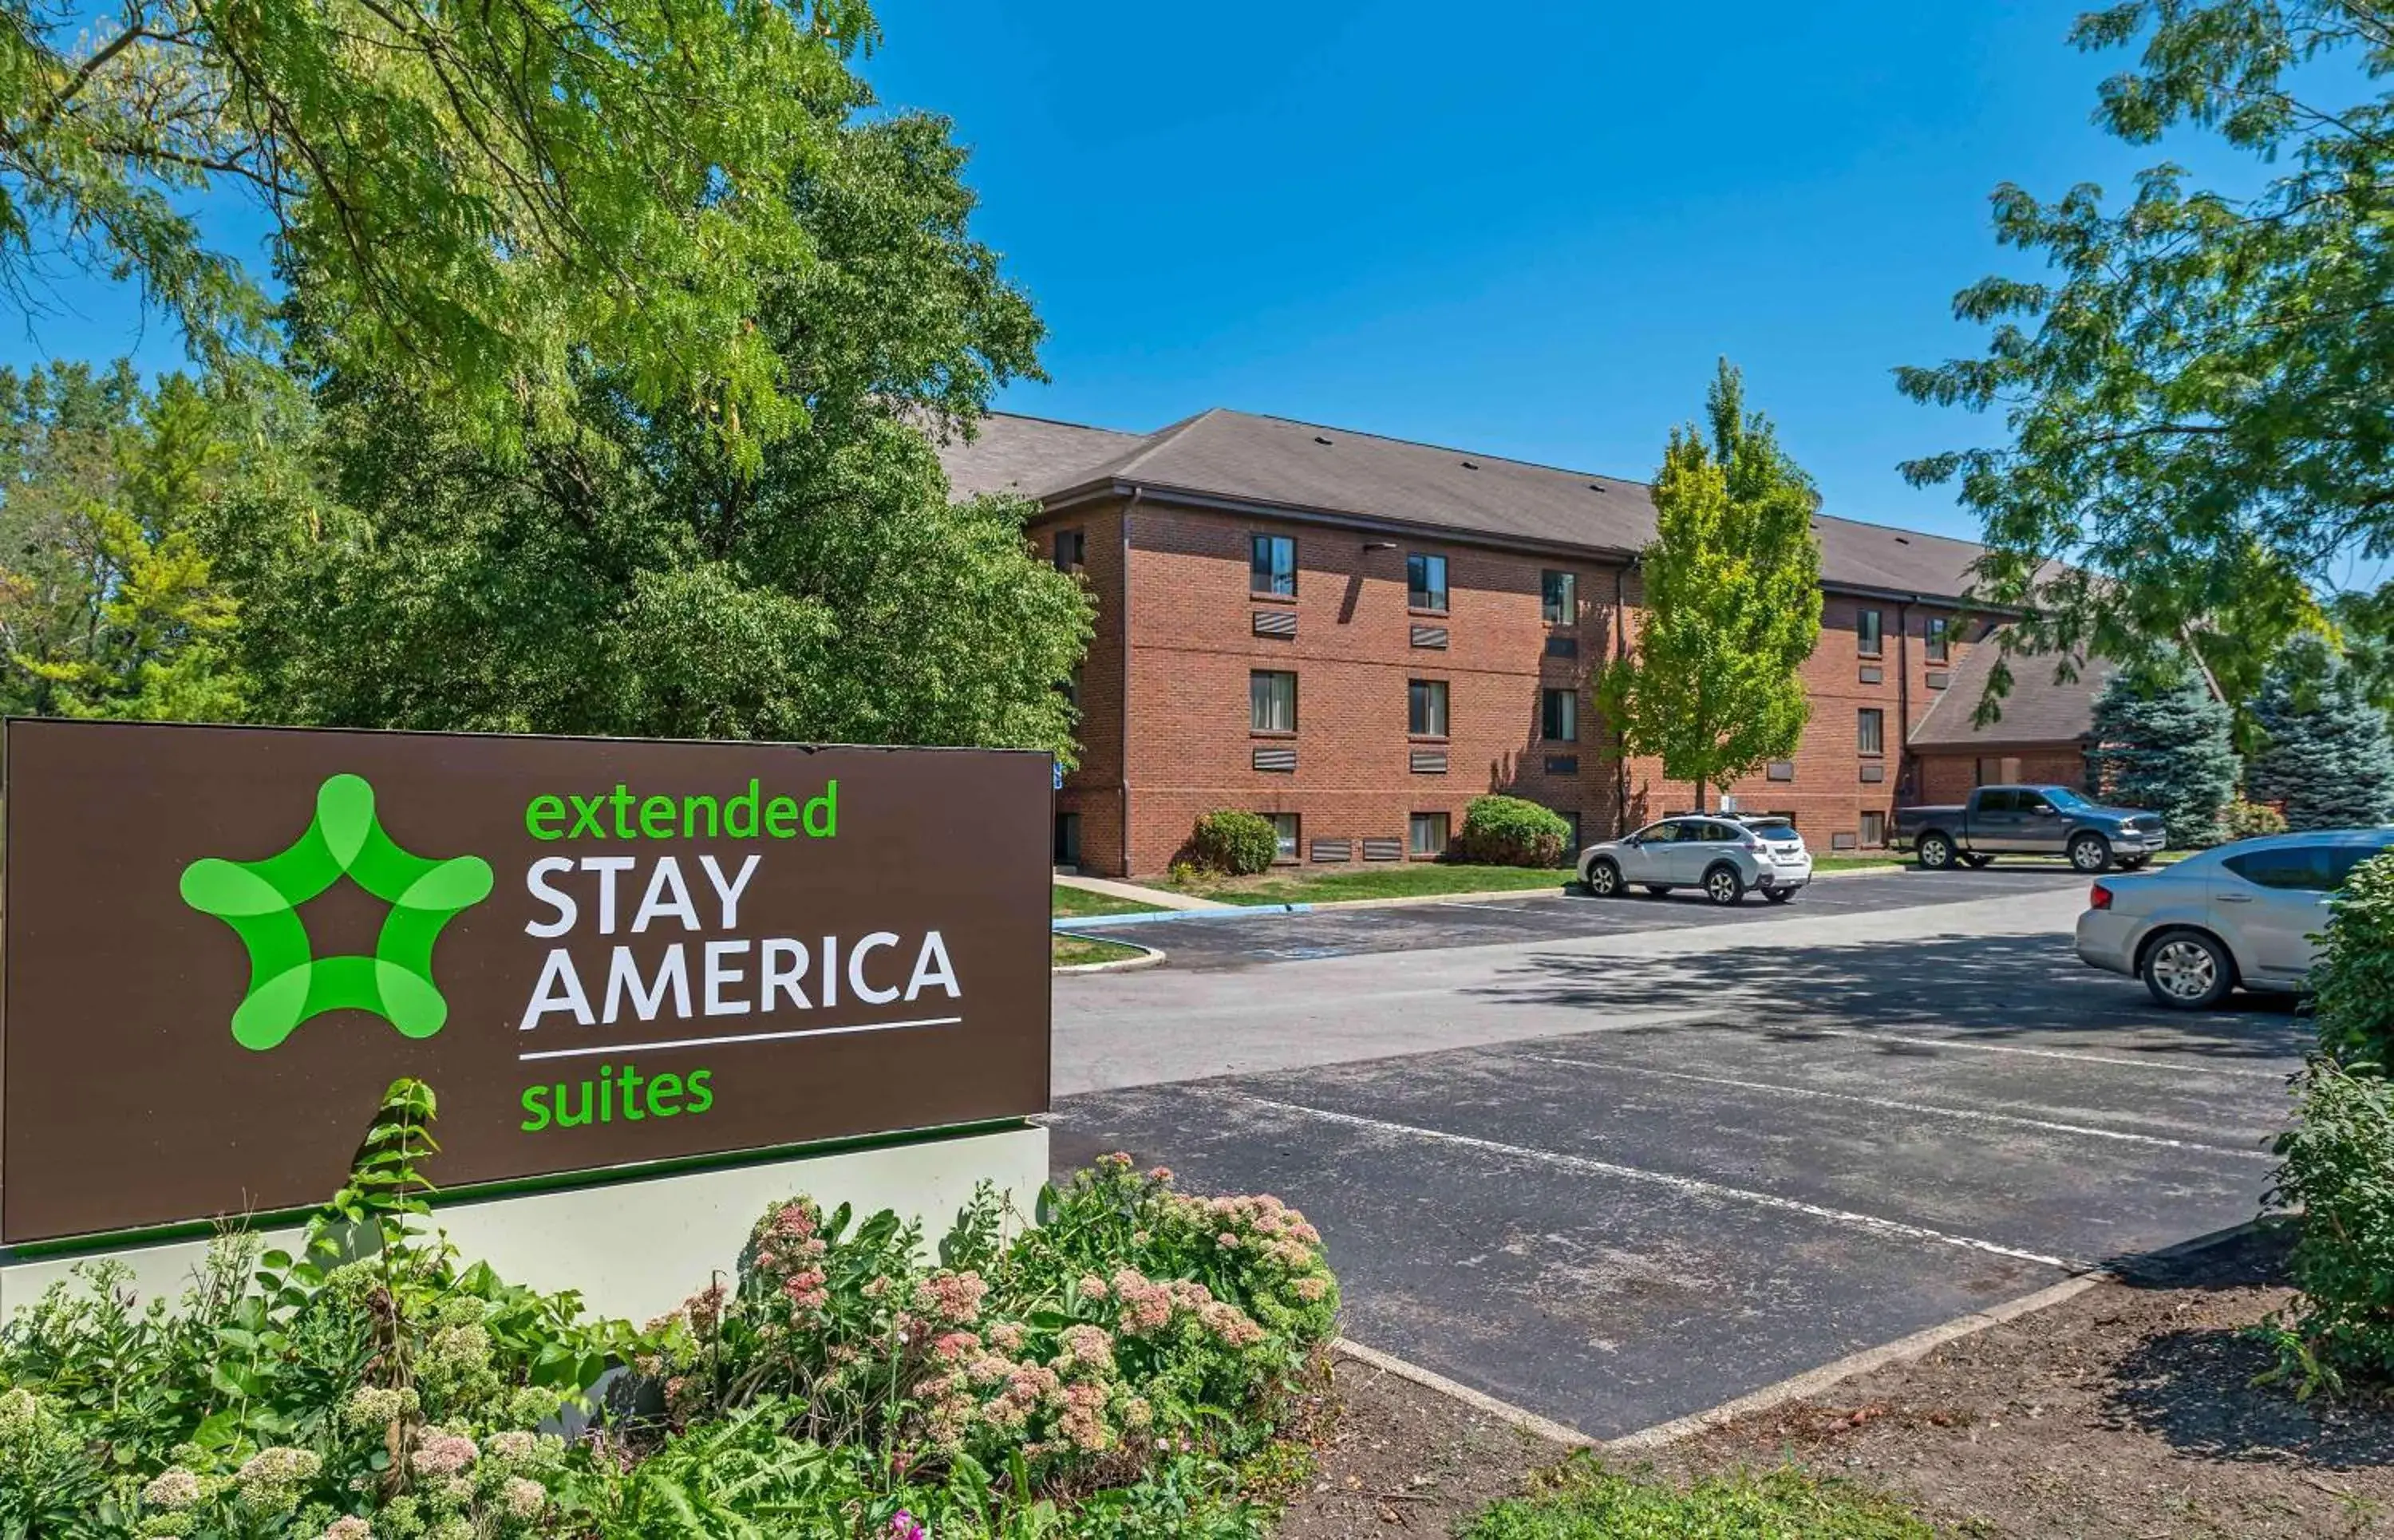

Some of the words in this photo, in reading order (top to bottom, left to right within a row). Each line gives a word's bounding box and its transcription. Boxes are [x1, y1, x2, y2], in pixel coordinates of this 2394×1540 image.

[525, 778, 838, 840] extended
[524, 855, 762, 938] STAY
[519, 930, 962, 1030] AMERICA
[520, 1065, 713, 1131] suites
